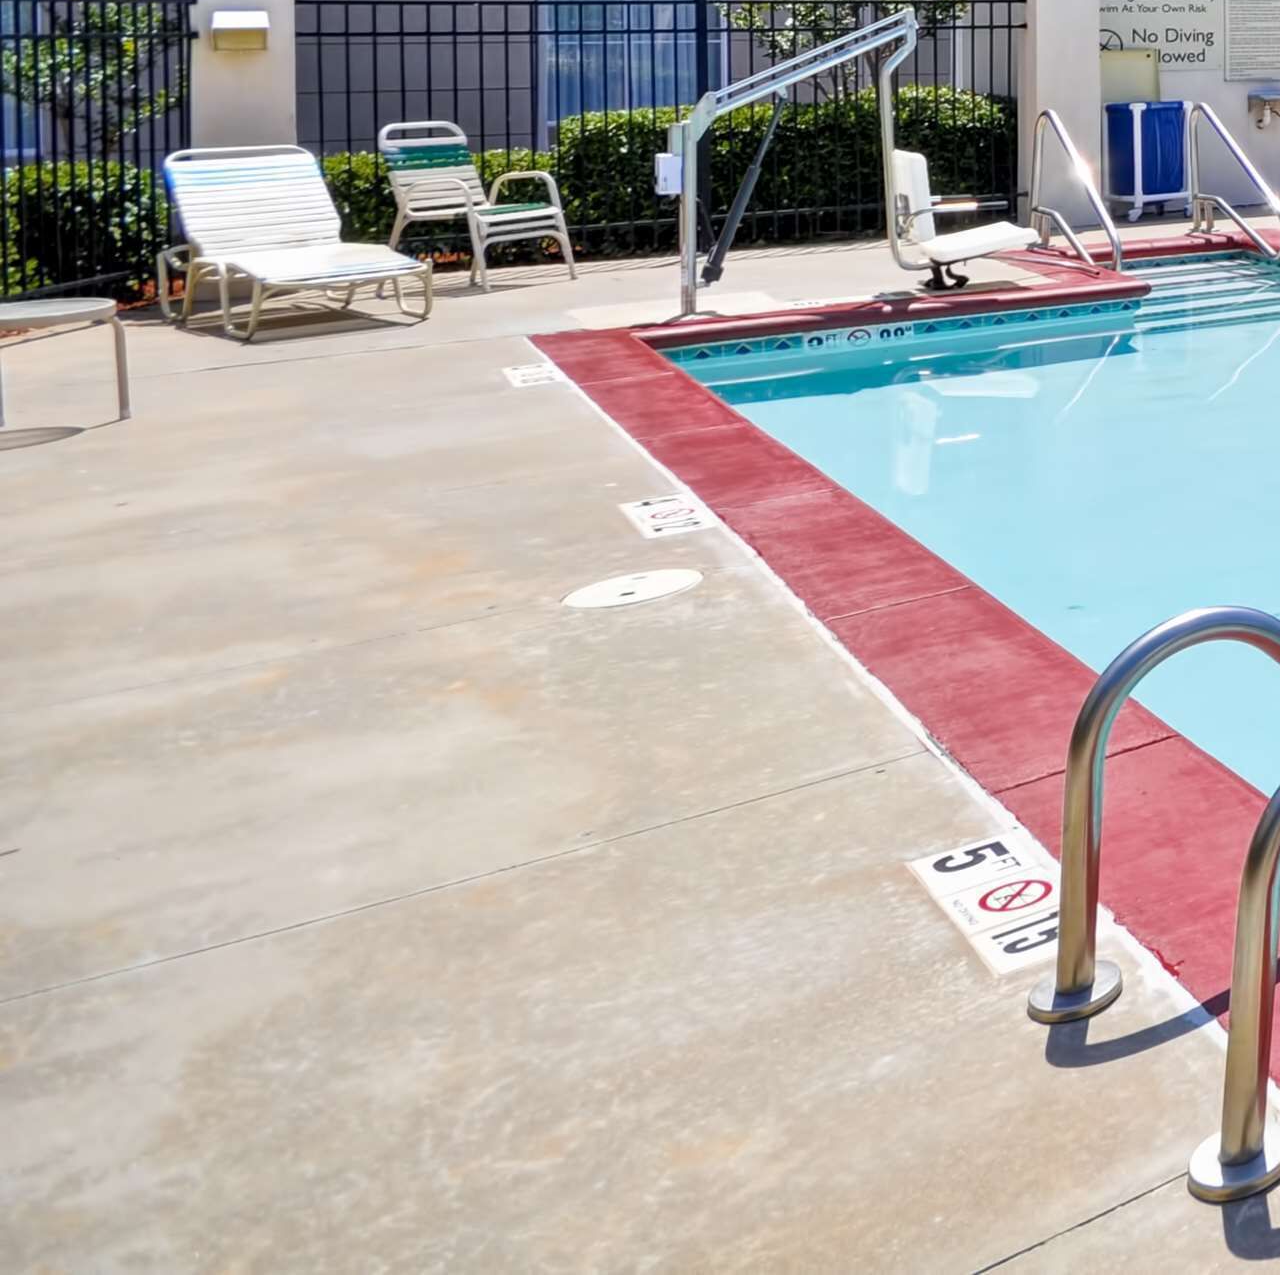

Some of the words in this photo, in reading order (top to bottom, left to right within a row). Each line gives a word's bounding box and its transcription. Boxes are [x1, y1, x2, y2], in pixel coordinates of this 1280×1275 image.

[1099, 5, 1118, 13] wim
[1122, 5, 1133, 13] At
[1137, 5, 1157, 13] Your
[1162, 4, 1185, 13] Own
[1189, 4, 1206, 13] Risk
[1132, 28, 1158, 43] No
[1165, 28, 1214, 46] Diving
[933, 841, 1010, 873] 5
